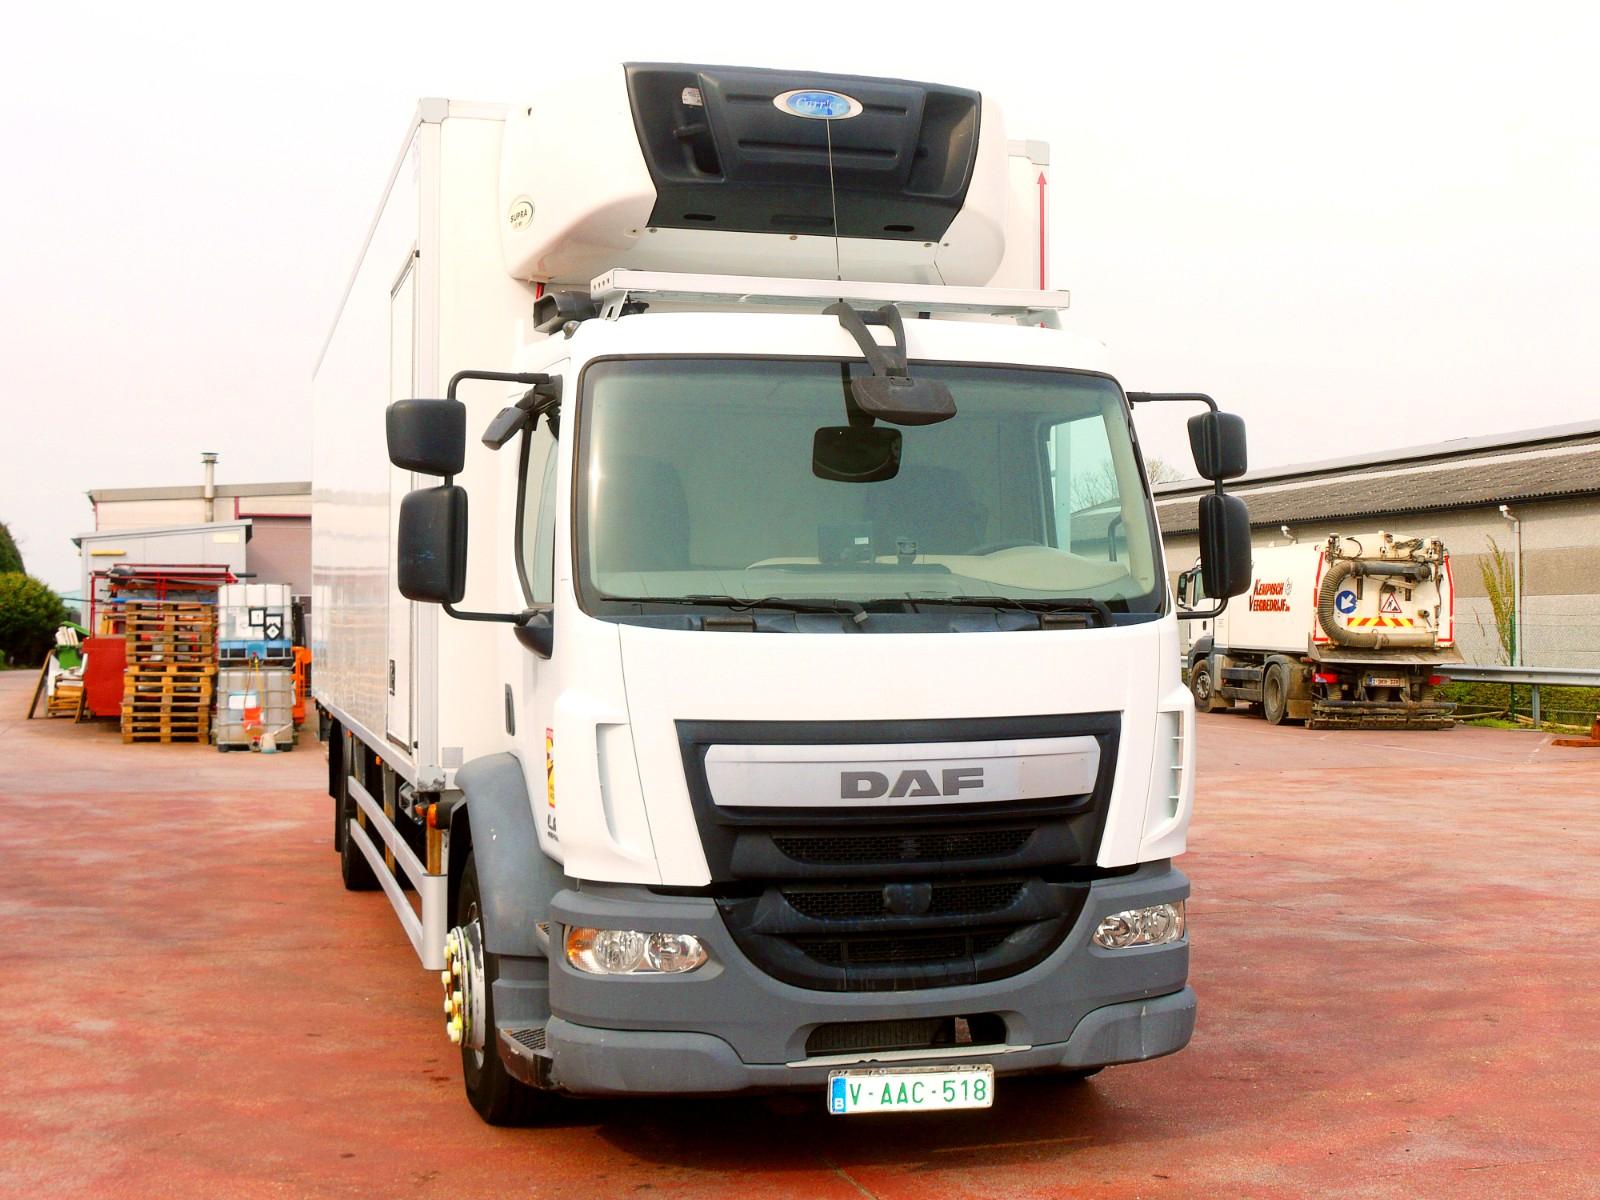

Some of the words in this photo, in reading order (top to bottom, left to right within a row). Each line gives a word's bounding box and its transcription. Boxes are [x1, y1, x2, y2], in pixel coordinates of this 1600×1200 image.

[510, 208, 528, 223] SUPRA
[1253, 578, 1285, 595] KEMPISCH
[841, 767, 984, 799] DAF
